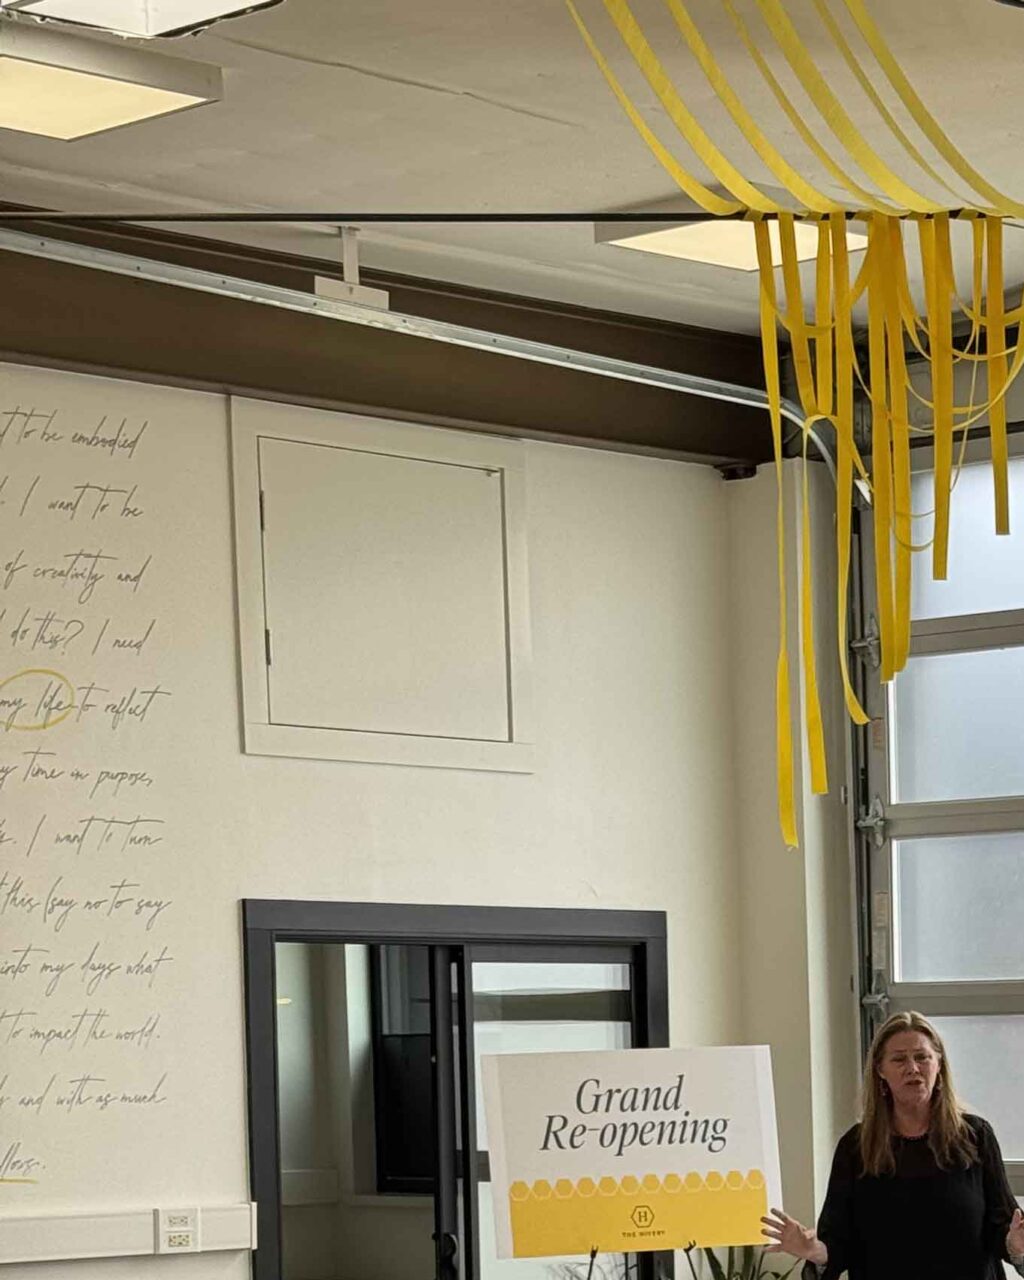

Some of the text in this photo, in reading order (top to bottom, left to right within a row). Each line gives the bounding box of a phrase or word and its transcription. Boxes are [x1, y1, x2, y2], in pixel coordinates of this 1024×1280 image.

[72, 415, 149, 459] embodied
[20, 475, 41, 517] I
[48, 483, 93, 520] want
[121, 484, 144, 517] be
[4, 549, 152, 604] of creativity and
[11, 607, 156, 656] do this? I need
[35, 680, 74, 729] life
[76, 682, 110, 723] to
[104, 684, 172, 730] reflect
[22, 746, 64, 782] time
[26, 813, 47, 857] I
[55, 815, 97, 855] want
[107, 878, 138, 917] to
[135, 899, 172, 932] say
[40, 962, 75, 997] my
[126, 946, 174, 989] what
[29, 1008, 91, 1056] impact
[83, 1008, 112, 1048] the
[19, 1073, 57, 1115] and
[56, 1074, 101, 1113] with
[96, 1092, 118, 1111] as
[120, 1072, 168, 1104] much
[576, 1074, 685, 1115] Grand
[539, 1111, 730, 1157] Re-opening
